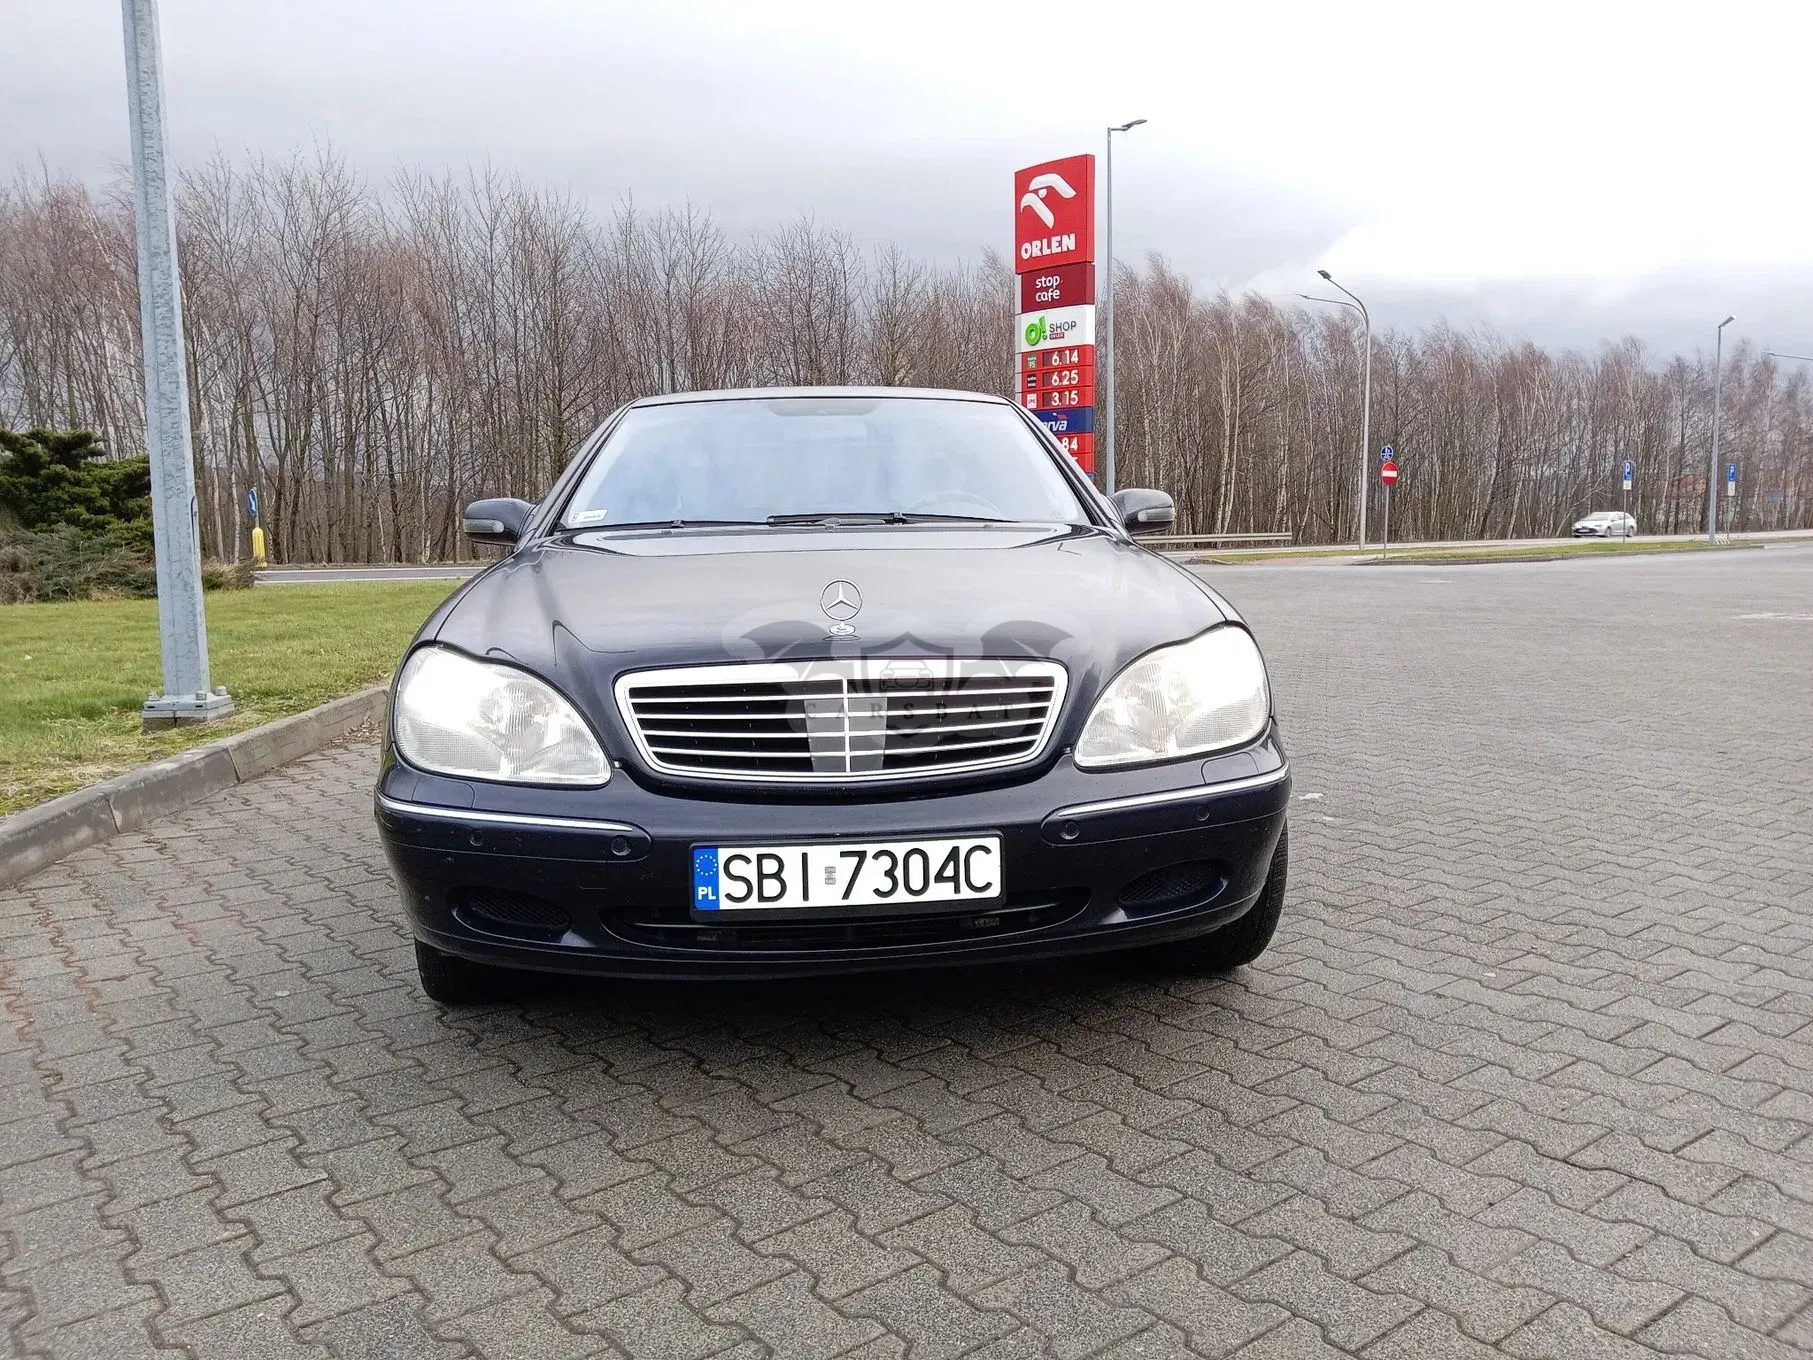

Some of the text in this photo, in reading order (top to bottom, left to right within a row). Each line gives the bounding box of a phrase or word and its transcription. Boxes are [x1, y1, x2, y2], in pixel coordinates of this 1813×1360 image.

[1021, 233, 1076, 260] ORLEN
[1035, 275, 1060, 289] stop
[1035, 288, 1060, 302] cafe
[1049, 320, 1077, 333] SHOP
[1051, 349, 1079, 366] 6.14
[1051, 369, 1079, 386] 6.25
[1051, 390, 1079, 406] 3.15
[723, 844, 993, 904] SBI 7304C
[697, 886, 716, 900] PL
